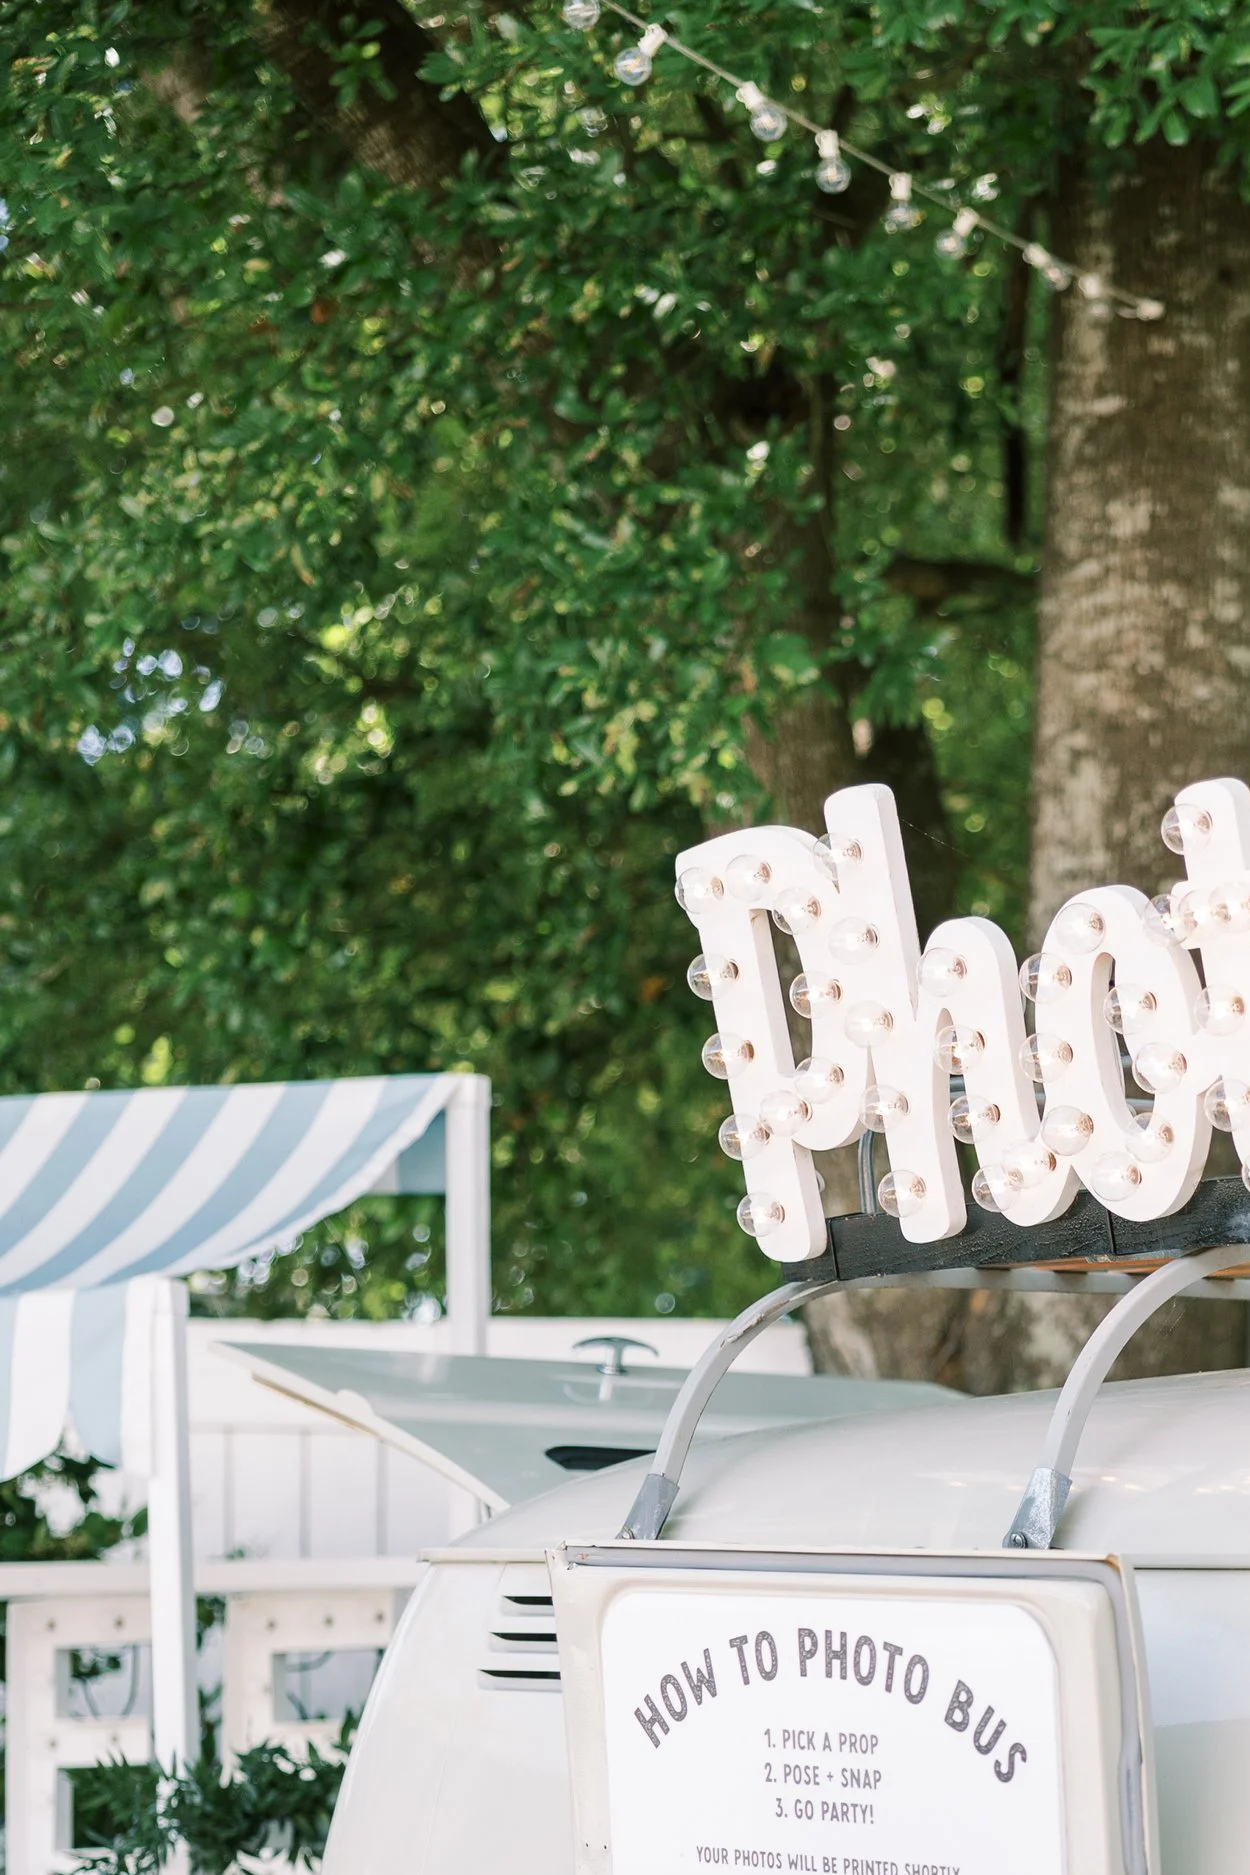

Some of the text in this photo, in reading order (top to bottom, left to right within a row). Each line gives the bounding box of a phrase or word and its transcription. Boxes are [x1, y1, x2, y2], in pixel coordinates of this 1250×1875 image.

[633, 1627, 1028, 1784] HOW TO PHOTO BUS
[763, 1727, 879, 1755] 1. PICK A PROP
[763, 1761, 778, 1783] 2.
[783, 1763, 821, 1787] POSE
[840, 1767, 882, 1791] SNAP
[775, 1797, 875, 1825] 3. GO PARTY!
[695, 1845, 729, 1866] YOUR
[734, 1848, 783, 1870] PHOTOS
[787, 1853, 818, 1873] WILL
[822, 1855, 838, 1875] BE
